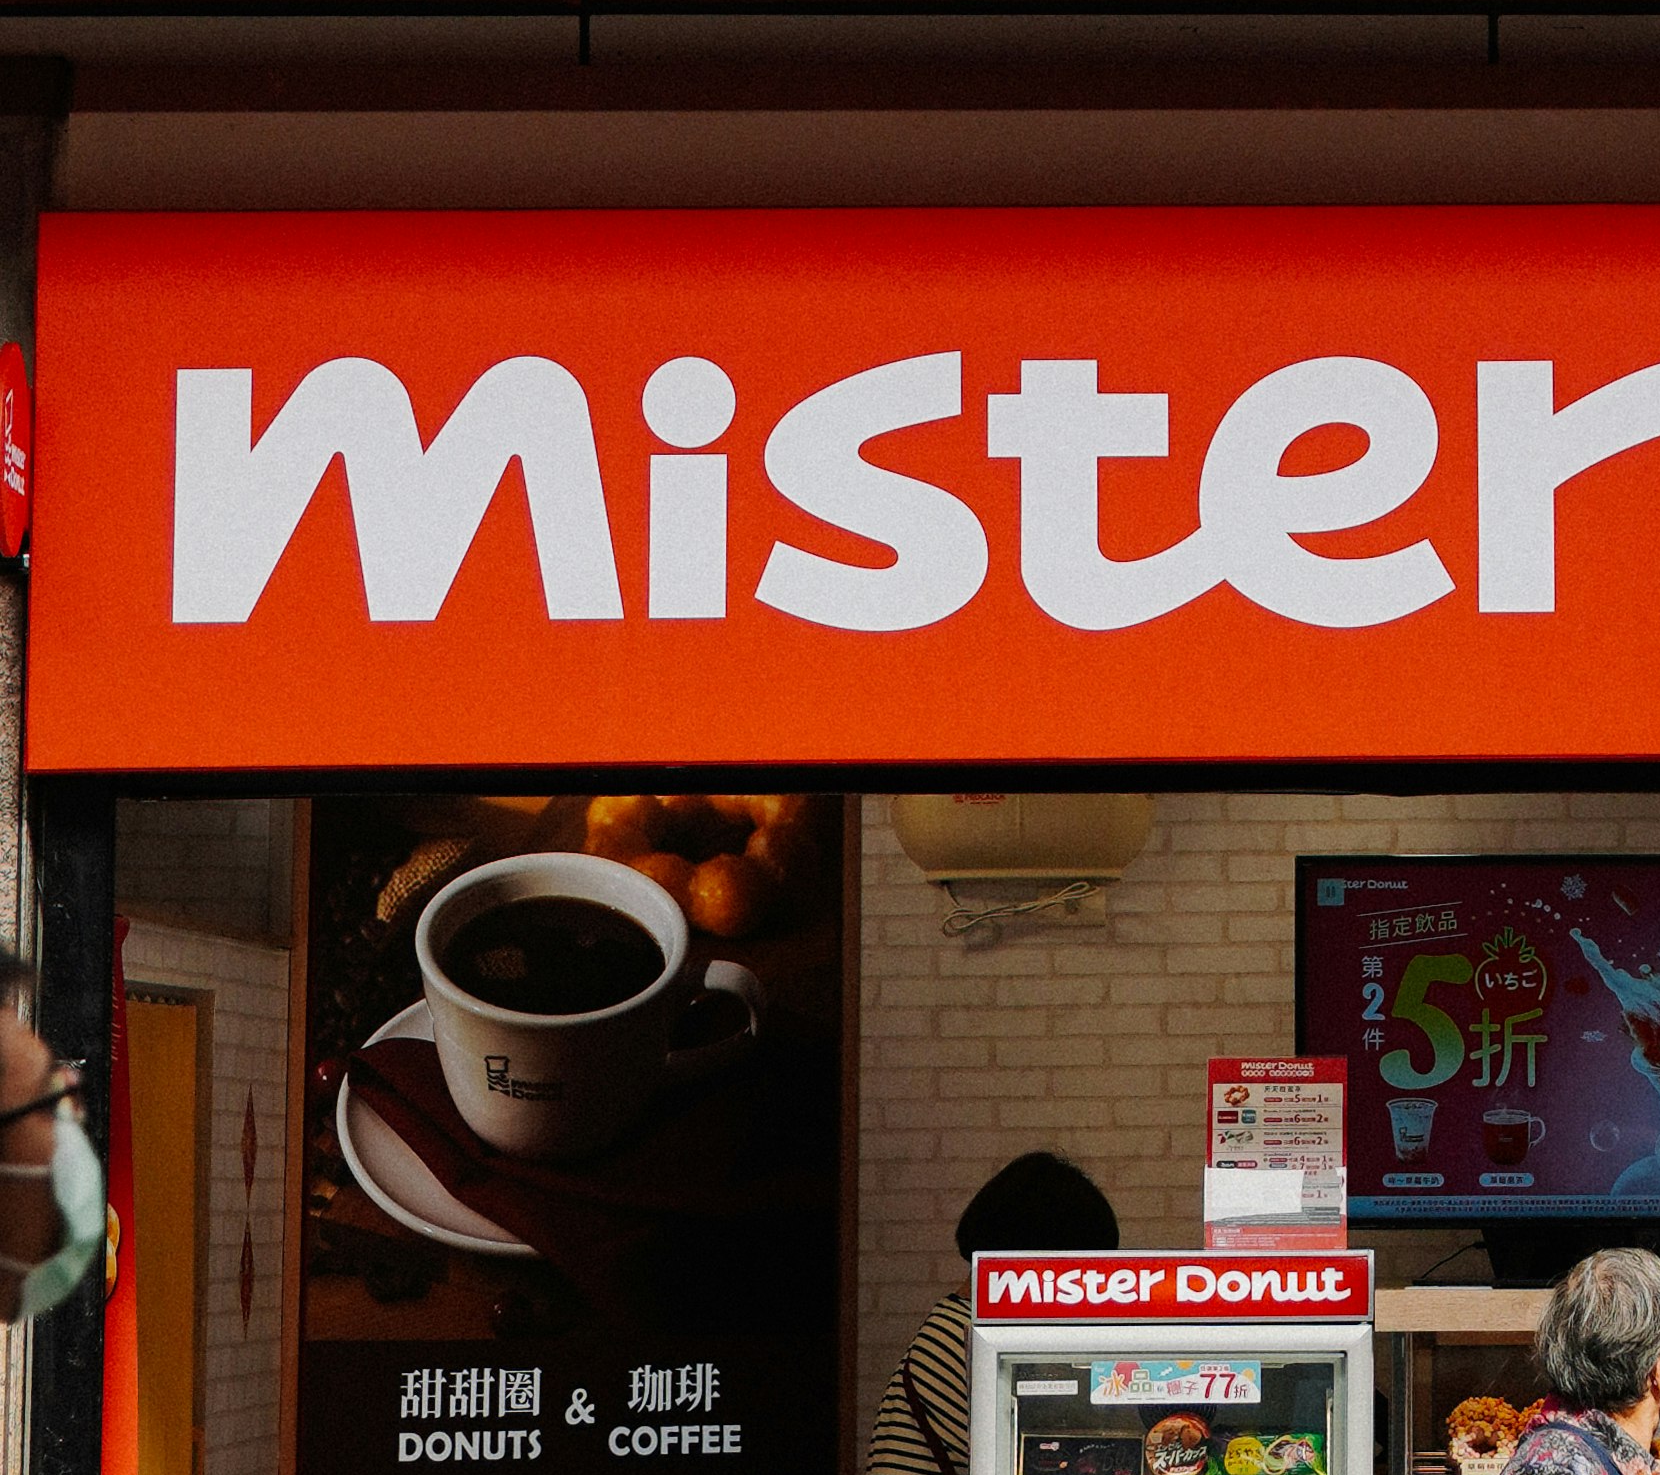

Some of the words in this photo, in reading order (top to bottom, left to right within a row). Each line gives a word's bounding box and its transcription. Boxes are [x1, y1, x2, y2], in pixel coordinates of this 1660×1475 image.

[1369, 910, 1458, 941] 指定飲品
[1484, 967, 1538, 991] いちご
[1361, 956, 1386, 1050] 第2件
[1177, 1266, 1351, 1302] Donut
[400, 1367, 542, 1419] 甜甜圈
[565, 1388, 595, 1425] &
[398, 1429, 542, 1462] DONUTS
[608, 1424, 742, 1456] COFFEE
